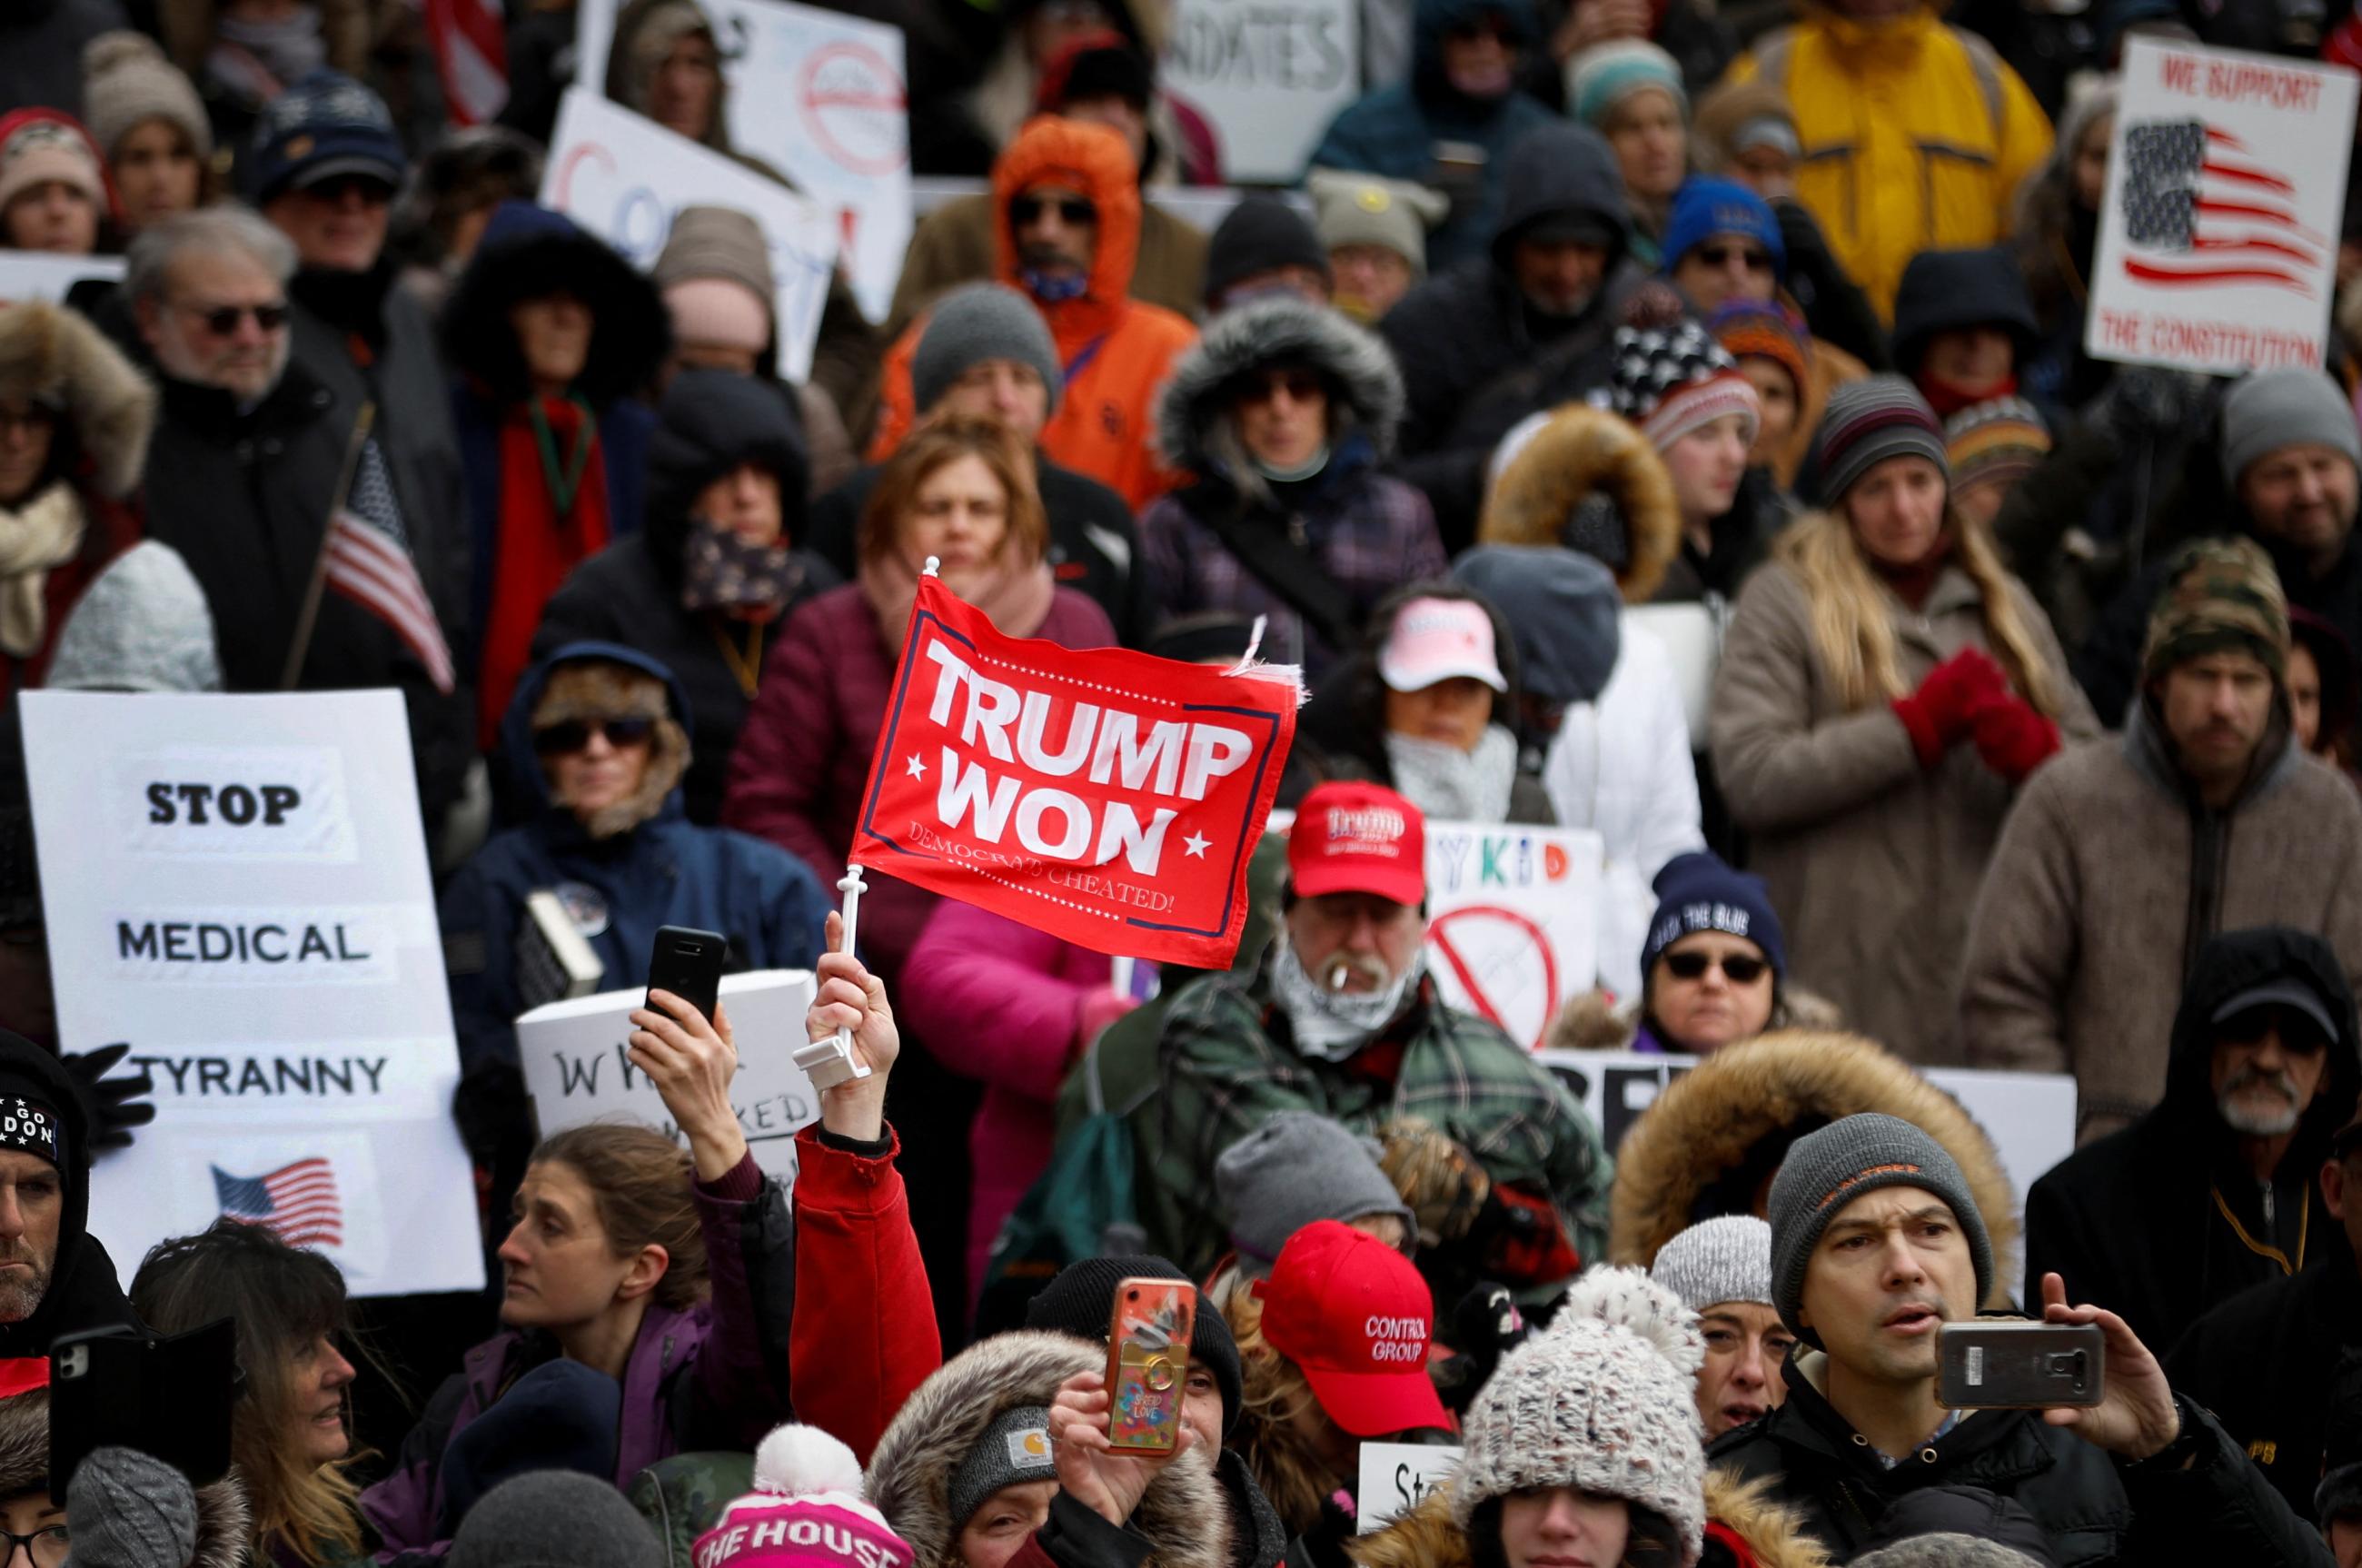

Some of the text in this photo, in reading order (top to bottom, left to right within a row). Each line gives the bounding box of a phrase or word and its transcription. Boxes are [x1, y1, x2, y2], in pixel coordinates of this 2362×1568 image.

[2159, 55, 2322, 110] WE SUPPORT
[2100, 309, 2323, 371] THE CONSTITUTION
[927, 637, 1253, 801] TRUMP
[145, 781, 302, 826] STOP
[937, 745, 1178, 877] WON
[1048, 867, 1175, 914] CHEATED!
[116, 919, 372, 964] MEDICAL
[129, 1056, 388, 1097] TYRANNY
[16, 1107, 45, 1125] GO
[1365, 1315, 1427, 1340] CONTROL
[1371, 1340, 1423, 1362] GROUP
[1134, 1406, 1158, 1419] LOVE
